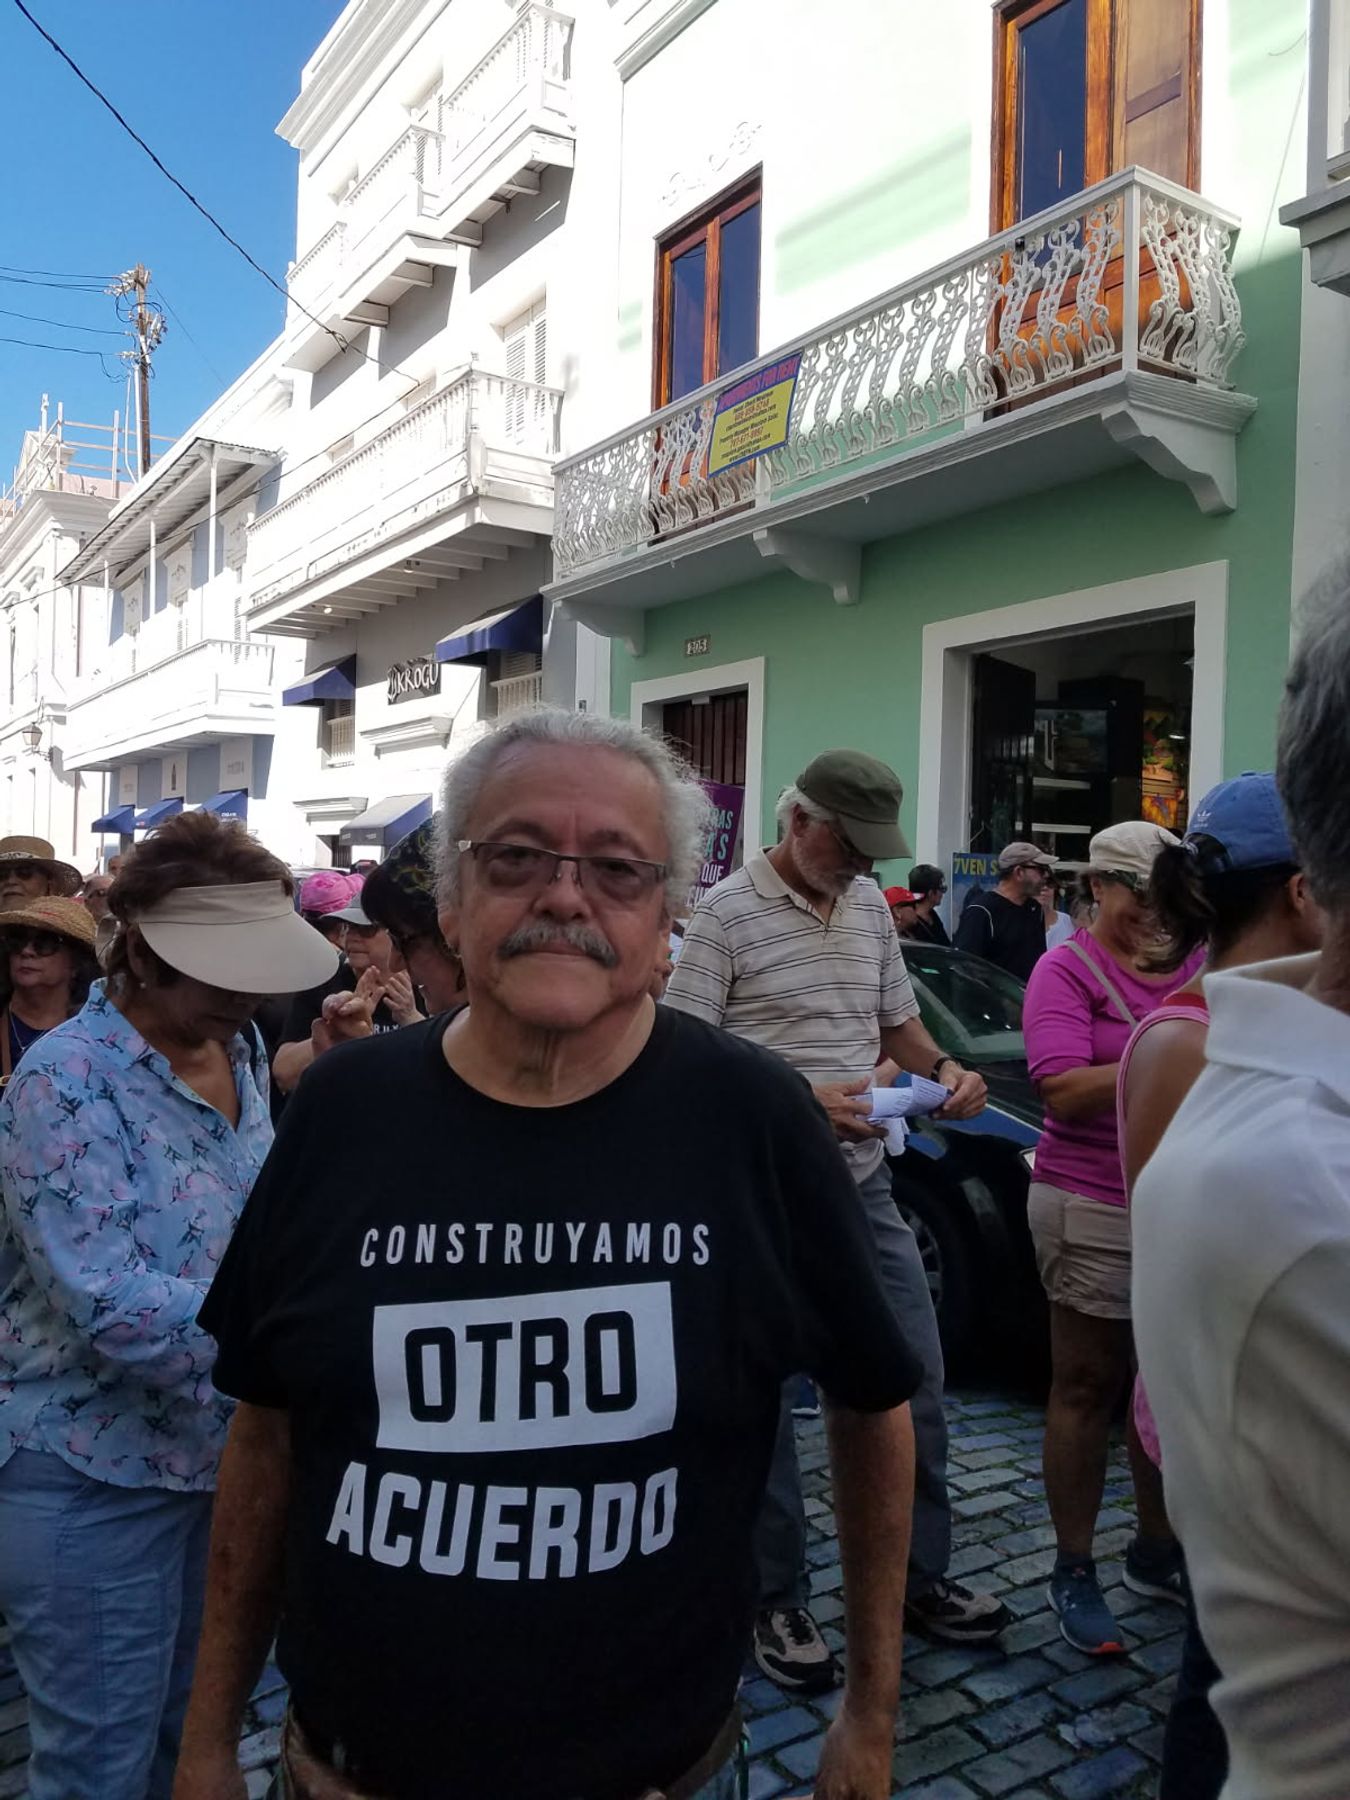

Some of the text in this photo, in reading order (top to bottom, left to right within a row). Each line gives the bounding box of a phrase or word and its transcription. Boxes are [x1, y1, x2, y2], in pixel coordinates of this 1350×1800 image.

[701, 862, 724, 884] QUE
[360, 1222, 710, 1267] CONSTRUYAMOS
[404, 1310, 638, 1424] OTRO
[325, 1461, 678, 1581] ACUERDO
